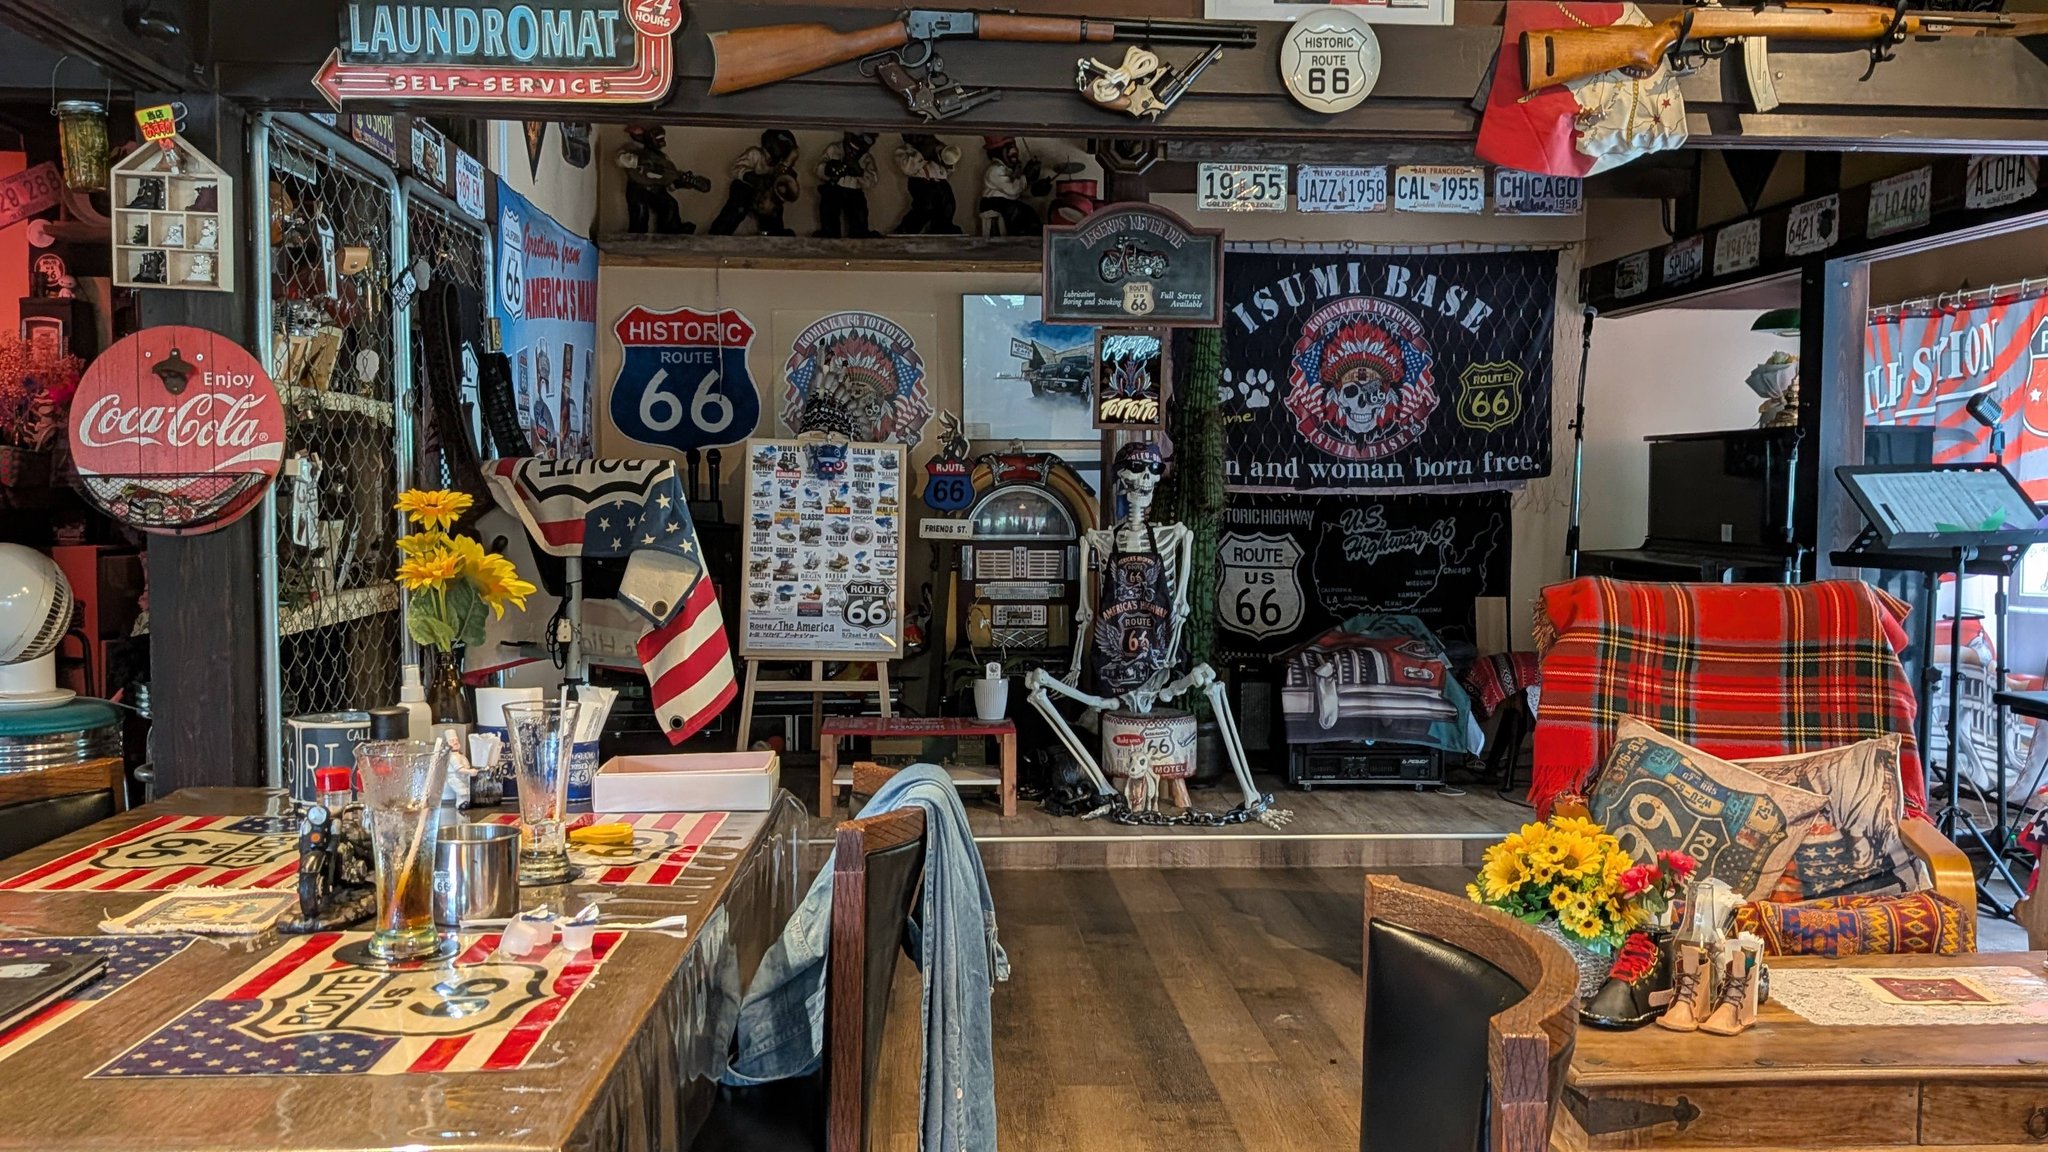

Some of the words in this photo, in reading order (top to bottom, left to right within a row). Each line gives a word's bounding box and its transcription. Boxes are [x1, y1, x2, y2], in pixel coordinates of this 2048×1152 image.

[635, 11, 671, 27] HOURS
[350, 3, 620, 61] LAUNDROMAT
[1305, 36, 1354, 50] HISTORIC
[1311, 55, 1346, 66] ROUTE
[393, 75, 602, 94] SELF-SERVICE
[1308, 68, 1350, 94] 66
[1975, 154, 2025, 197] ALOHA
[1300, 179, 1337, 203] JAZZ
[1348, 179, 1385, 203] 1958
[1398, 176, 1430, 200] CAL
[1442, 177, 1479, 201] 1955
[1555, 199, 1577, 209] 1958
[505, 257, 521, 305] 66
[525, 279, 576, 321] AMERICA'S
[1063, 290, 1096, 298] Lubrication
[1063, 298, 1082, 308] Boring
[1084, 298, 1096, 306] and
[1097, 298, 1123, 308] Stroking
[1177, 292, 1202, 300] Service
[1232, 262, 1361, 334] ISUMI
[1384, 264, 1493, 334] BASE
[1131, 300, 1148, 311] 66
[1170, 300, 1203, 308] Available
[629, 321, 743, 343] HISTORIC
[660, 351, 713, 364] ROUTE
[203, 371, 254, 388] Enjoy
[1473, 373, 1513, 386] ROUTE
[639, 367, 734, 433] 66
[1471, 389, 1510, 418] 66
[936, 463, 966, 473] ROUTE
[1250, 458, 1299, 478] and
[1307, 462, 1404, 479] woman
[1414, 456, 1472, 477] born
[1483, 451, 1541, 473] free.
[933, 480, 965, 503] 66
[925, 524, 953, 533] FRIENDS
[957, 525, 968, 533] ST.
[1261, 509, 1314, 531] HIGHWAY
[1233, 547, 1284, 563] ROUTE
[1129, 572, 1142, 583] 66
[1244, 572, 1275, 585] US
[850, 585, 885, 594] ROUTE
[1235, 587, 1282, 626] 66
[1327, 596, 1338, 604] LA
[847, 600, 887, 624] 66
[1102, 601, 1138, 620] AMERICA'S
[796, 622, 835, 632] America
[1125, 618, 1152, 627] ROUTE
[1128, 630, 1150, 652] 66
[1154, 765, 1185, 774] MOTEL
[126, 838, 210, 861] 66
[279, 973, 380, 1028] ROUTE
[374, 985, 417, 1011] US
